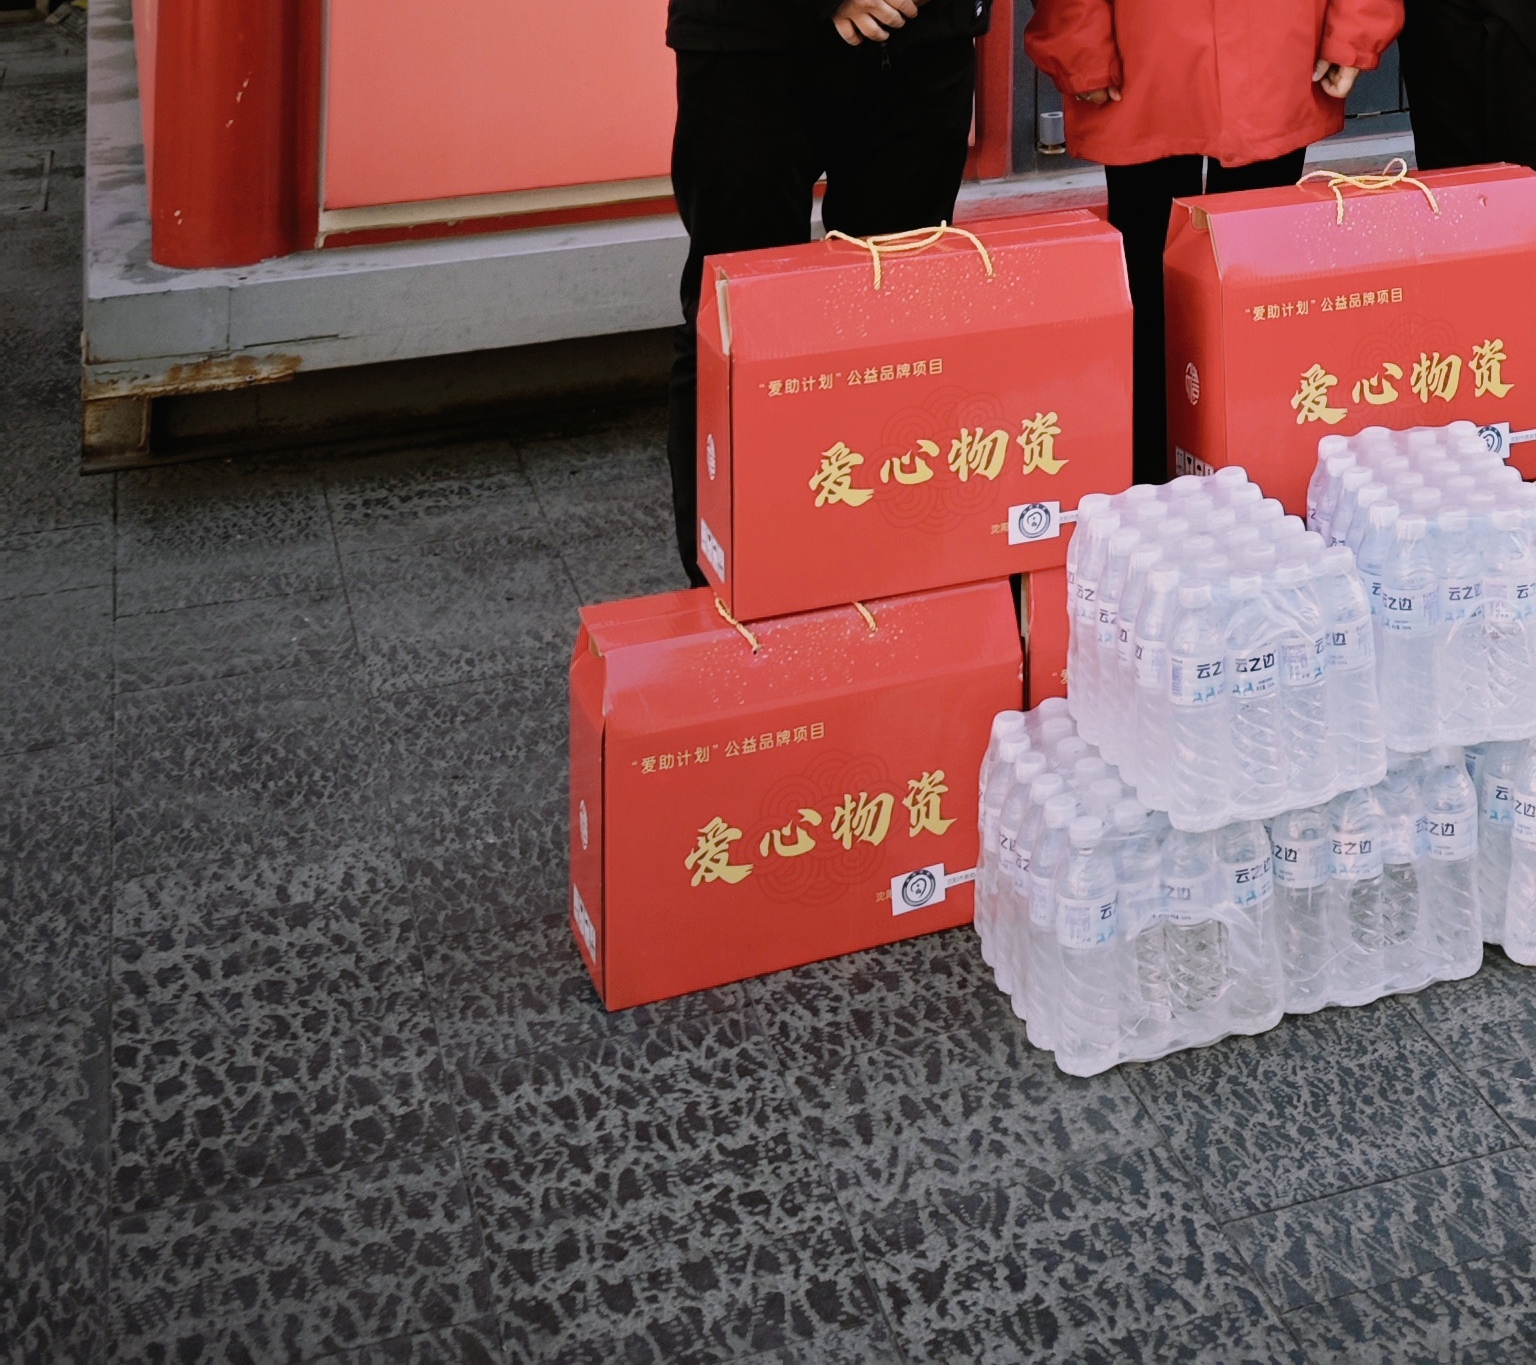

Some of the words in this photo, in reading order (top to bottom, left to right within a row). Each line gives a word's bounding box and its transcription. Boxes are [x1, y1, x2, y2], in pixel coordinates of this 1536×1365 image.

[1291, 339, 1515, 425] 爱心物资
[810, 412, 1069, 507] 爱心物资
[684, 770, 957, 887] 爱心物资
